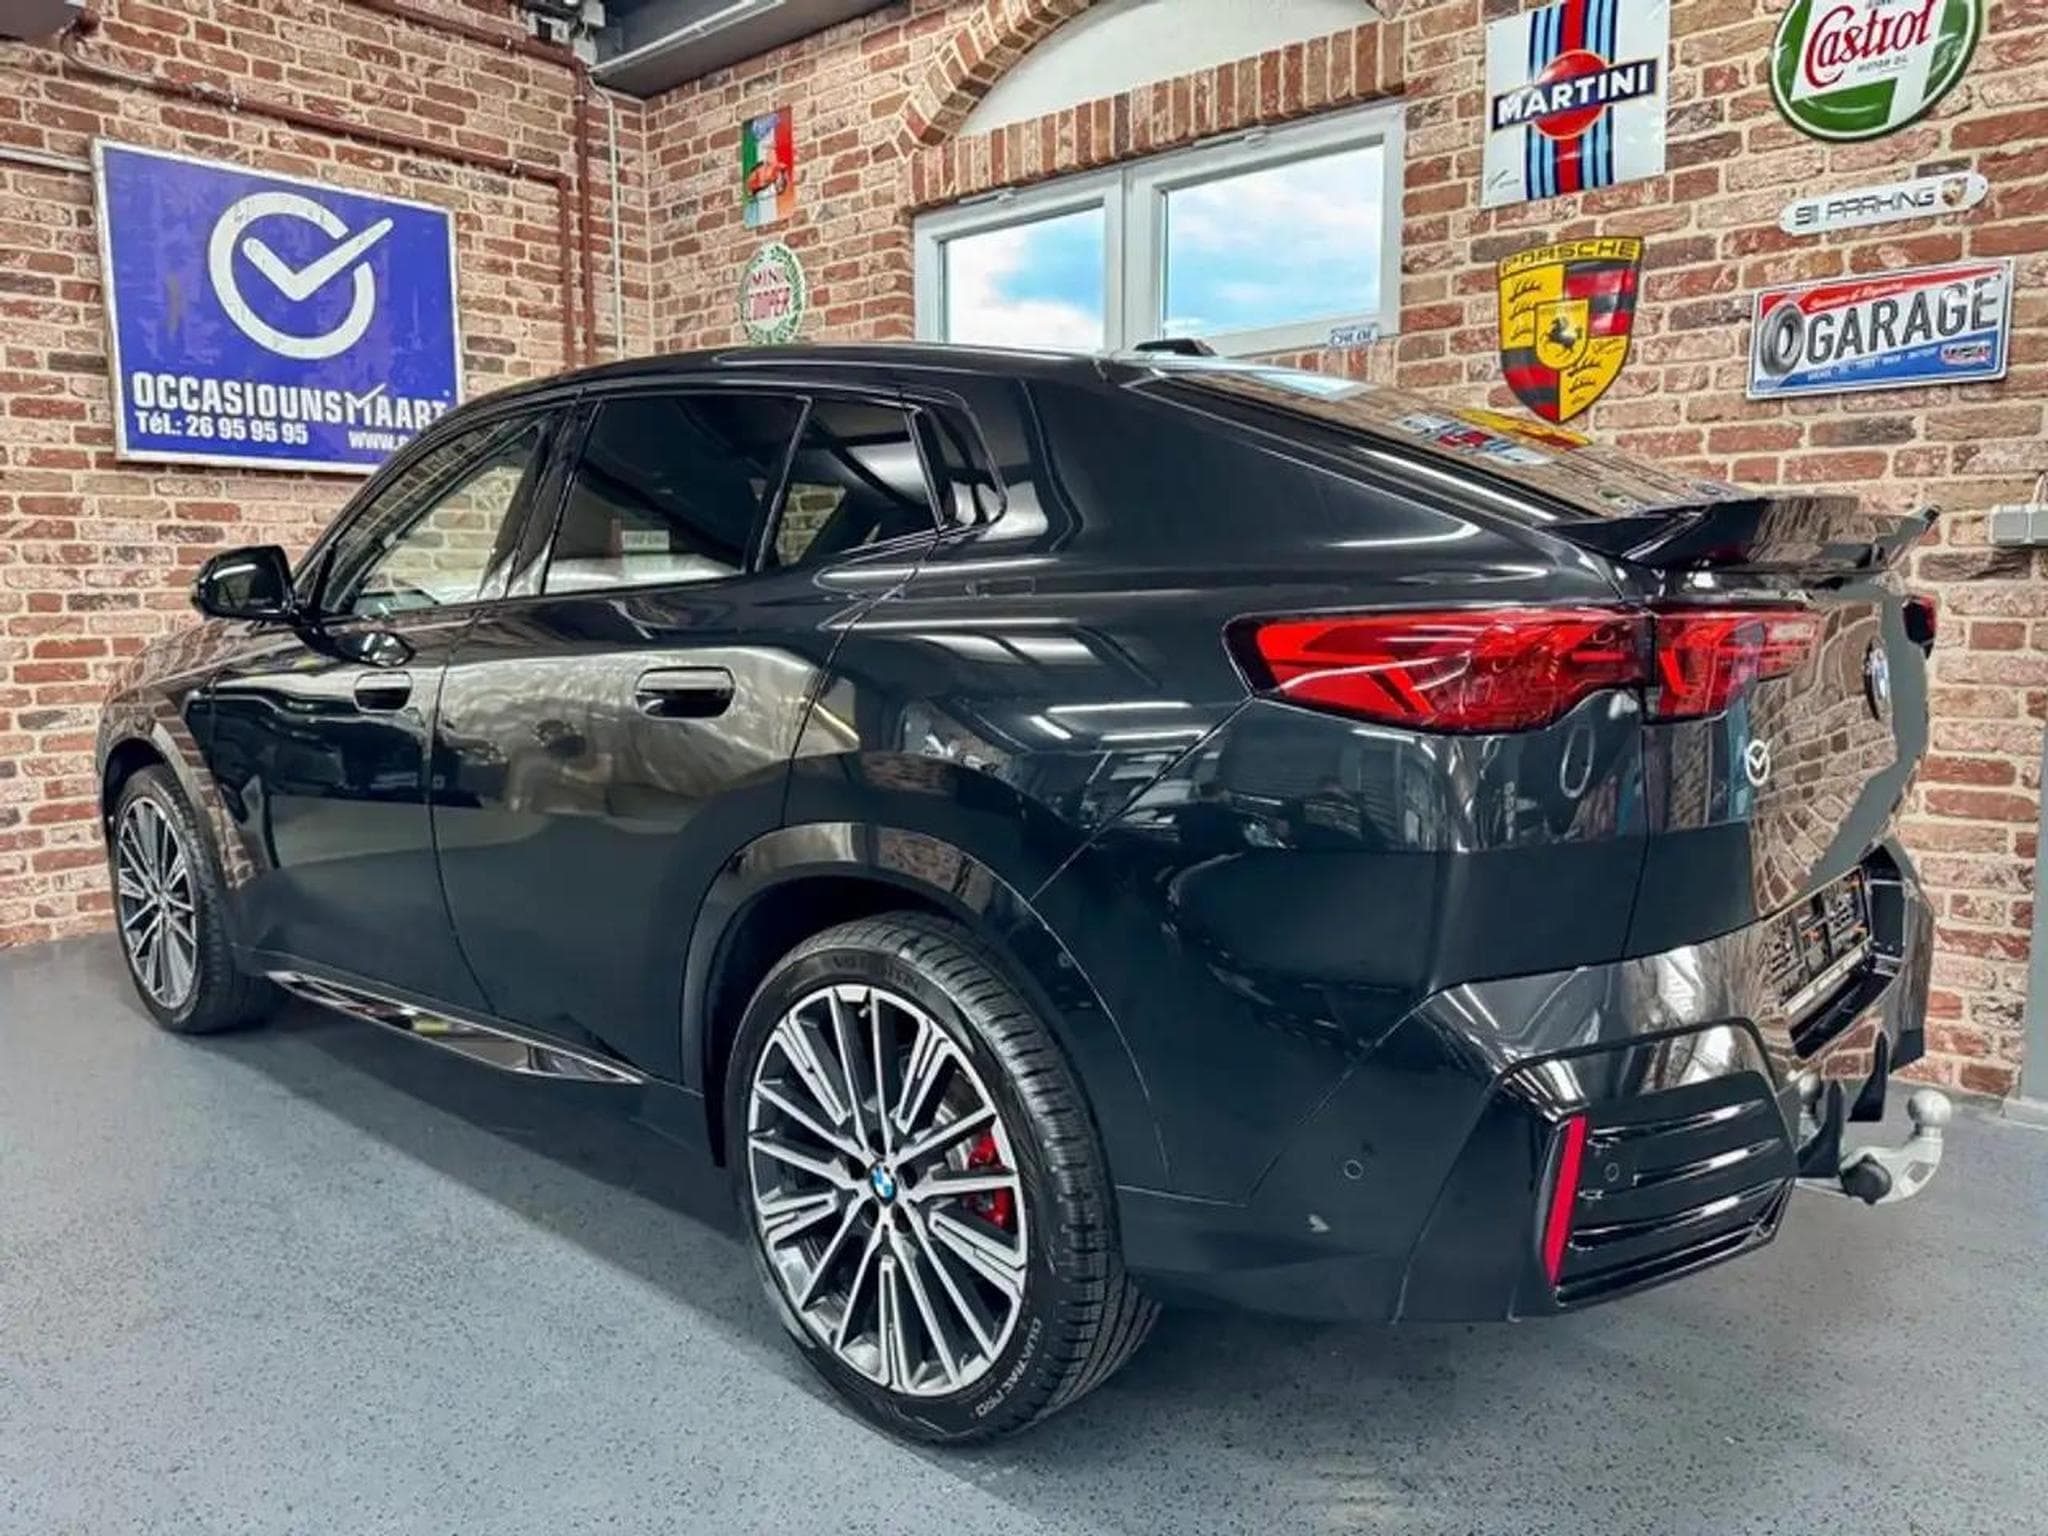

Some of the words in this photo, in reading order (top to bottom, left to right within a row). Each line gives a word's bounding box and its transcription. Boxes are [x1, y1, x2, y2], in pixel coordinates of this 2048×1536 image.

[1804, 0, 1938, 89] Castrol
[1497, 63, 1650, 126] MARTINI
[1826, 186, 1937, 221] PARKING
[1502, 239, 1636, 272] PORSCHE
[1806, 275, 2002, 366] GARAGE
[134, 410, 183, 436] Tél.:
[185, 414, 215, 439] 26
[217, 416, 247, 441] 95
[250, 419, 279, 444] 95
[281, 421, 310, 446] 95
